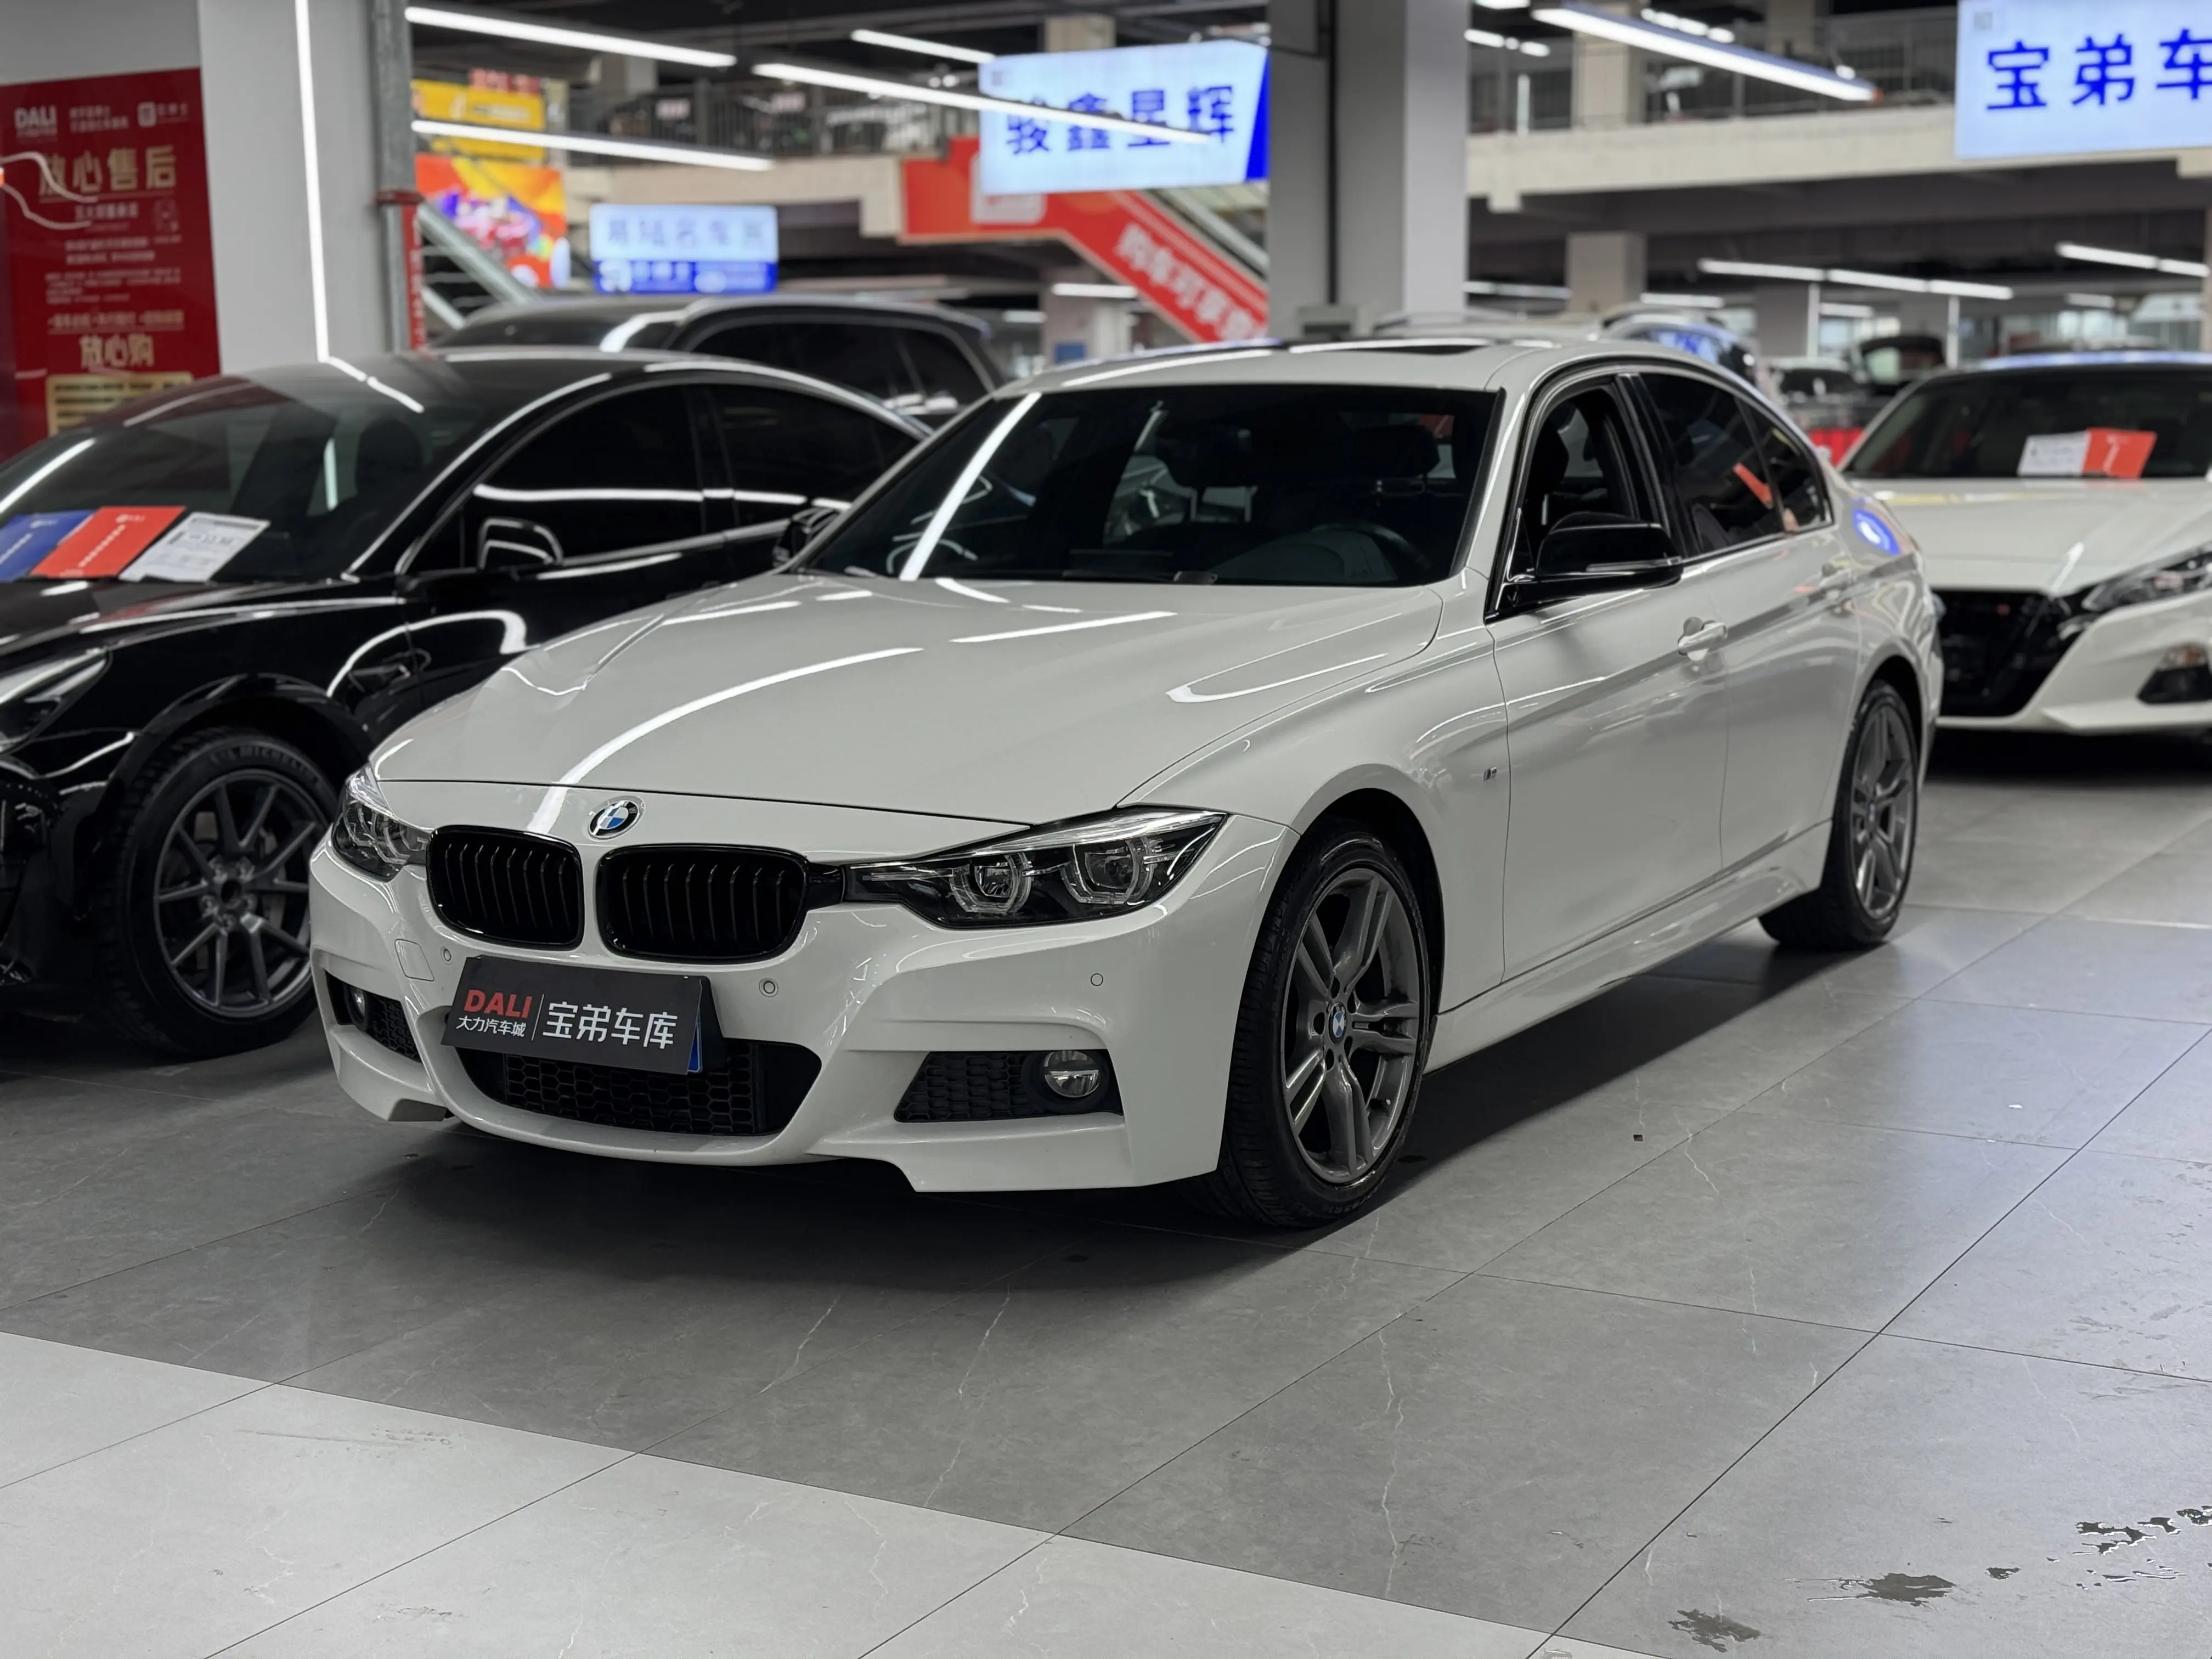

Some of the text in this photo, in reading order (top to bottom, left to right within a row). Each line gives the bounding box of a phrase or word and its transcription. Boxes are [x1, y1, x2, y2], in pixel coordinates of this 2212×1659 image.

[1986, 29, 2212, 110] 宝弟车
[15, 105, 57, 129] DALI
[464, 989, 533, 1019] DALI
[456, 1015, 527, 1037] 大力汽车城
[543, 1001, 678, 1049] 宝弟车库
